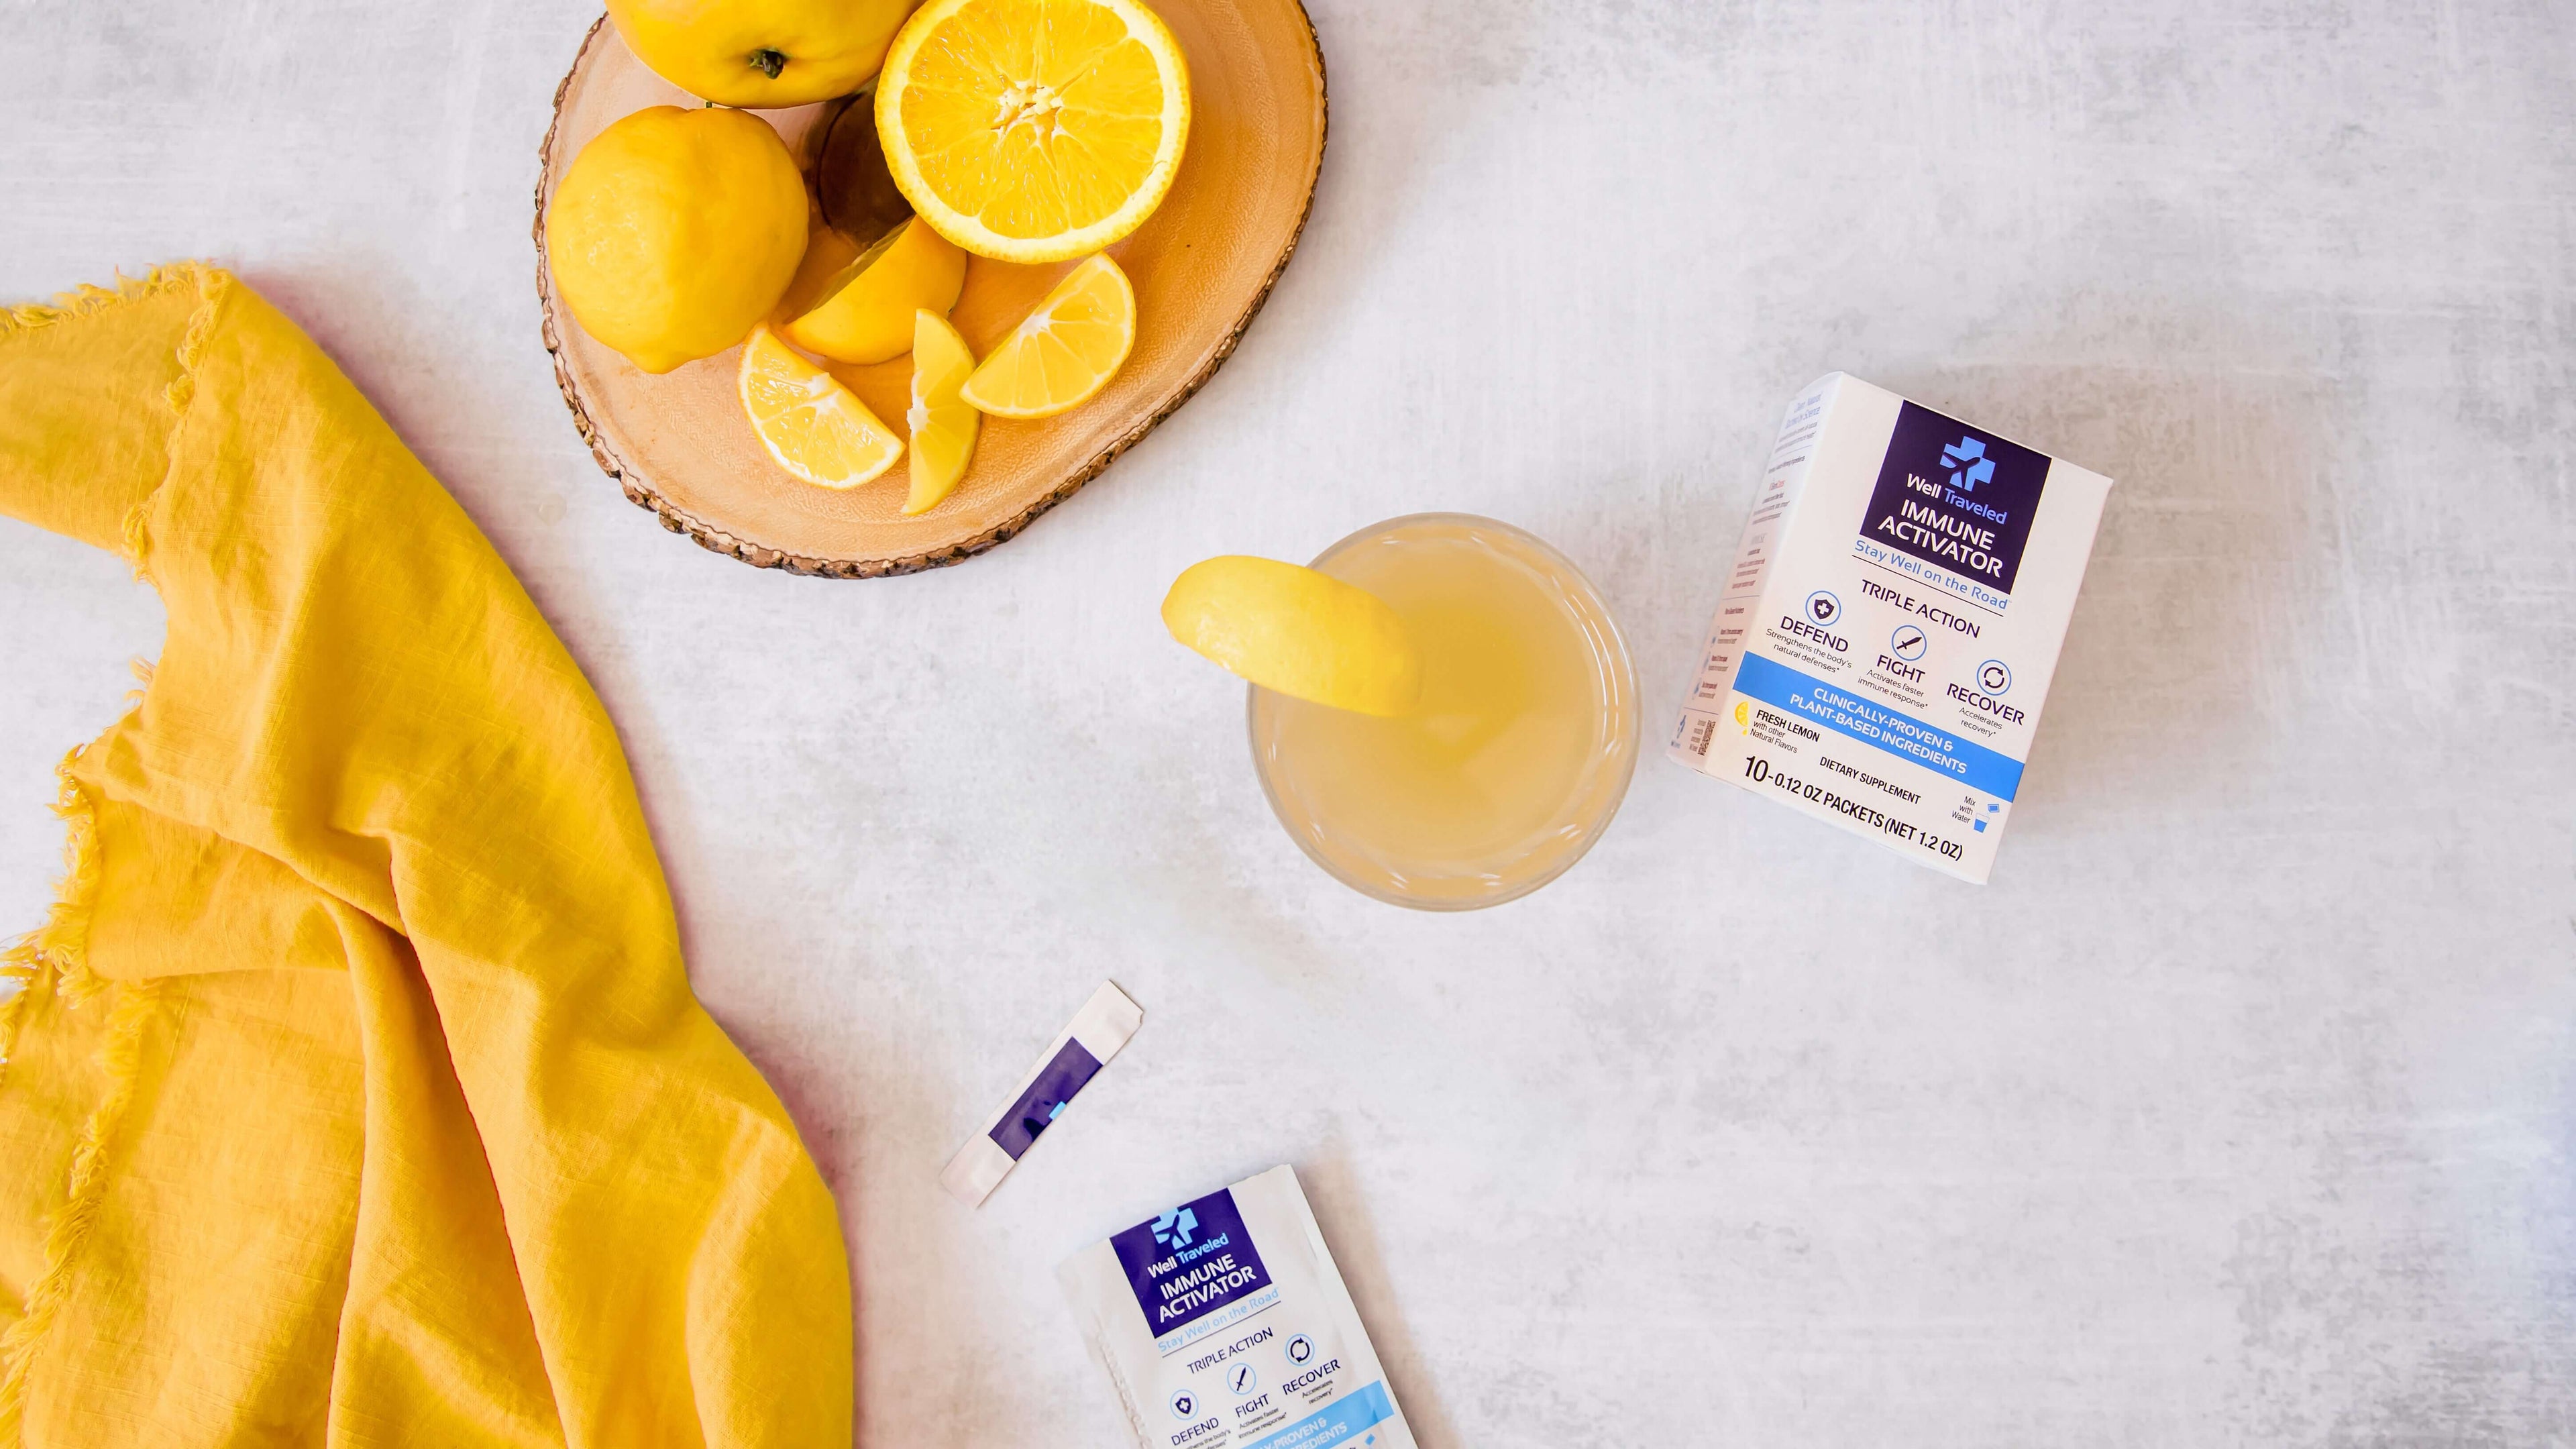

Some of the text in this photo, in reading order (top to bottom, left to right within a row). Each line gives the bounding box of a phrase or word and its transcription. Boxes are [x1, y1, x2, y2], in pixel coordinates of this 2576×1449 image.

[1906, 473, 2008, 525] Well Traveled
[1900, 499, 1996, 551] IMMUNE
[1878, 515, 2003, 578] ACTIVATOR
[1854, 539, 1888, 562] Stay
[1890, 553, 1921, 575] Well
[1924, 570, 1942, 583] on
[1945, 576, 1968, 594] the
[1862, 579, 1980, 639] TRIPLE ACTION
[1766, 628, 1813, 653] Strengthens
[1813, 647, 1827, 658] the
[1773, 643, 1801, 659] natural
[1780, 615, 1849, 653] DEFEND
[1858, 676, 1889, 695] immune
[1866, 669, 1925, 698] Activates faster
[1876, 654, 1926, 684] FIGHT
[1813, 687, 1954, 752] CLINICALLY-PROVEN &
[1946, 683, 2025, 726] RECOVER
[1958, 706, 2002, 730] Accelerates
[1750, 728, 1799, 754] Natural Flavors
[1753, 720, 1786, 739] with other
[1756, 709, 1821, 743] FRESH LEMON
[1790, 694, 1968, 774] PLANT-BASED INGREDIENTS
[1819, 756, 1921, 804] DIETARY SUPPLEMENT
[1951, 810, 1971, 824] Water
[1959, 804, 1974, 816] with
[1964, 796, 1976, 807] Mix
[1803, 784, 1823, 803] OZ
[1823, 792, 1885, 828] PACKETS
[1884, 817, 1917, 841] (NET
[1919, 831, 1939, 851] 1.2
[1939, 840, 1964, 862] OZ)
[1147, 1232, 1230, 1279] Well Traveled
[1159, 1253, 1237, 1300] IMMUNE
[1159, 1265, 1257, 1324] ACTIVATOR
[1158, 1335, 1183, 1352] Stay
[1184, 1320, 1211, 1340] Well
[1213, 1315, 1228, 1327] on
[1228, 1303, 1248, 1320] the
[1187, 1326, 1274, 1375] TRIPLE ACTION
[1282, 1358, 1341, 1396] RECOVER
[1234, 1393, 1270, 1418] FIGHT
[1263, 1407, 1279, 1418] faster
[1317, 1417, 1327, 1428] &
[1171, 1417, 1220, 1446] DEFEND
[1238, 1425, 1260, 1440] immune
